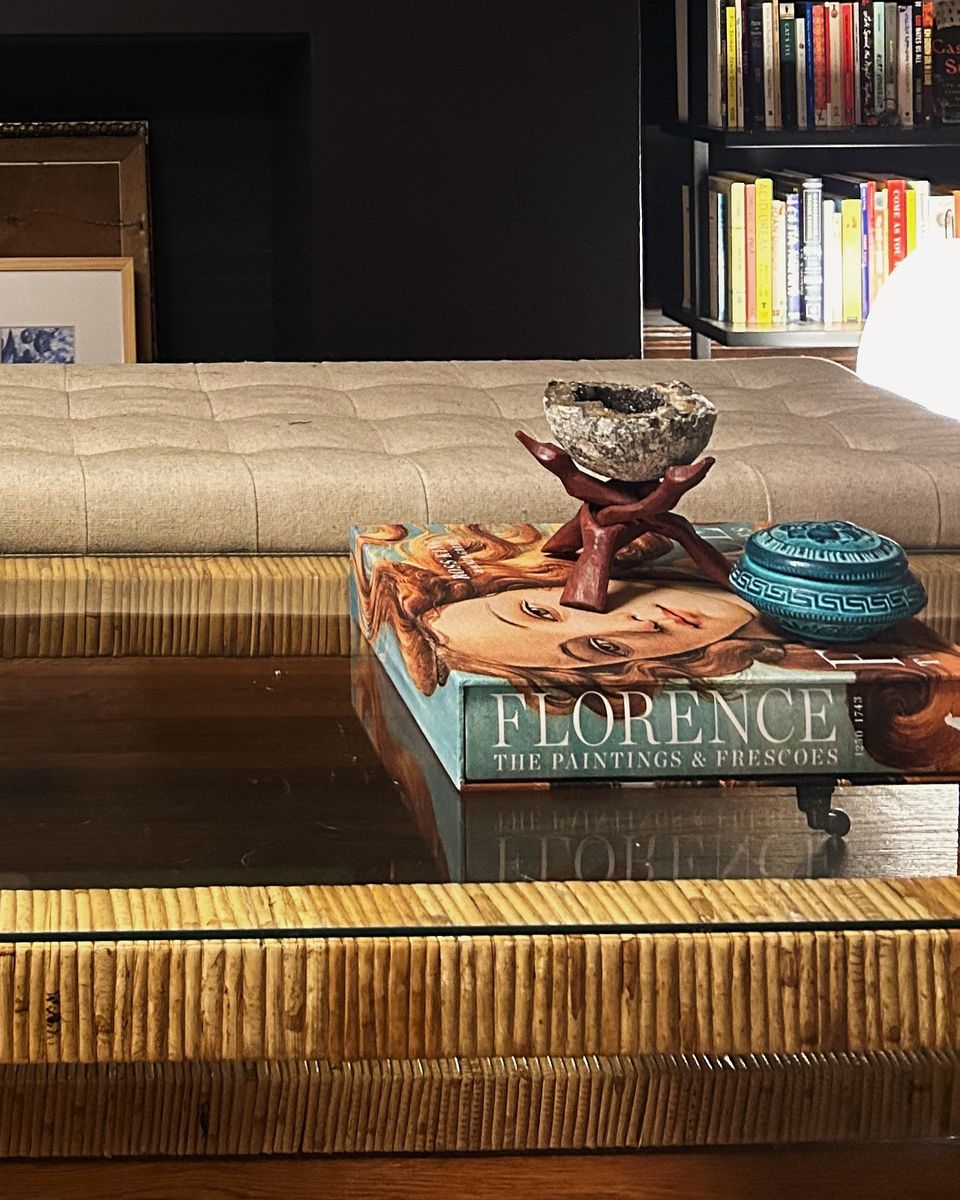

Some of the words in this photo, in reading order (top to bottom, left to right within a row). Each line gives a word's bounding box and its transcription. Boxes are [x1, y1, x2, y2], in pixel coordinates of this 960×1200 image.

[861, 28, 872, 48] Spend
[863, 49, 871, 60] the
[915, 45, 922, 53] US
[860, 60, 872, 80] Night
[758, 183, 768, 212] ACID
[893, 189, 901, 218] COME
[893, 221, 901, 234] AS
[893, 237, 902, 257] YOU
[440, 560, 471, 580] ROSS
[490, 688, 837, 749] FLORENCE
[853, 695, 865, 723] 1743
[494, 751, 541, 771] THE
[552, 750, 681, 771] PAINTINGS
[691, 749, 707, 770] &
[717, 746, 839, 769] FRESCOES
